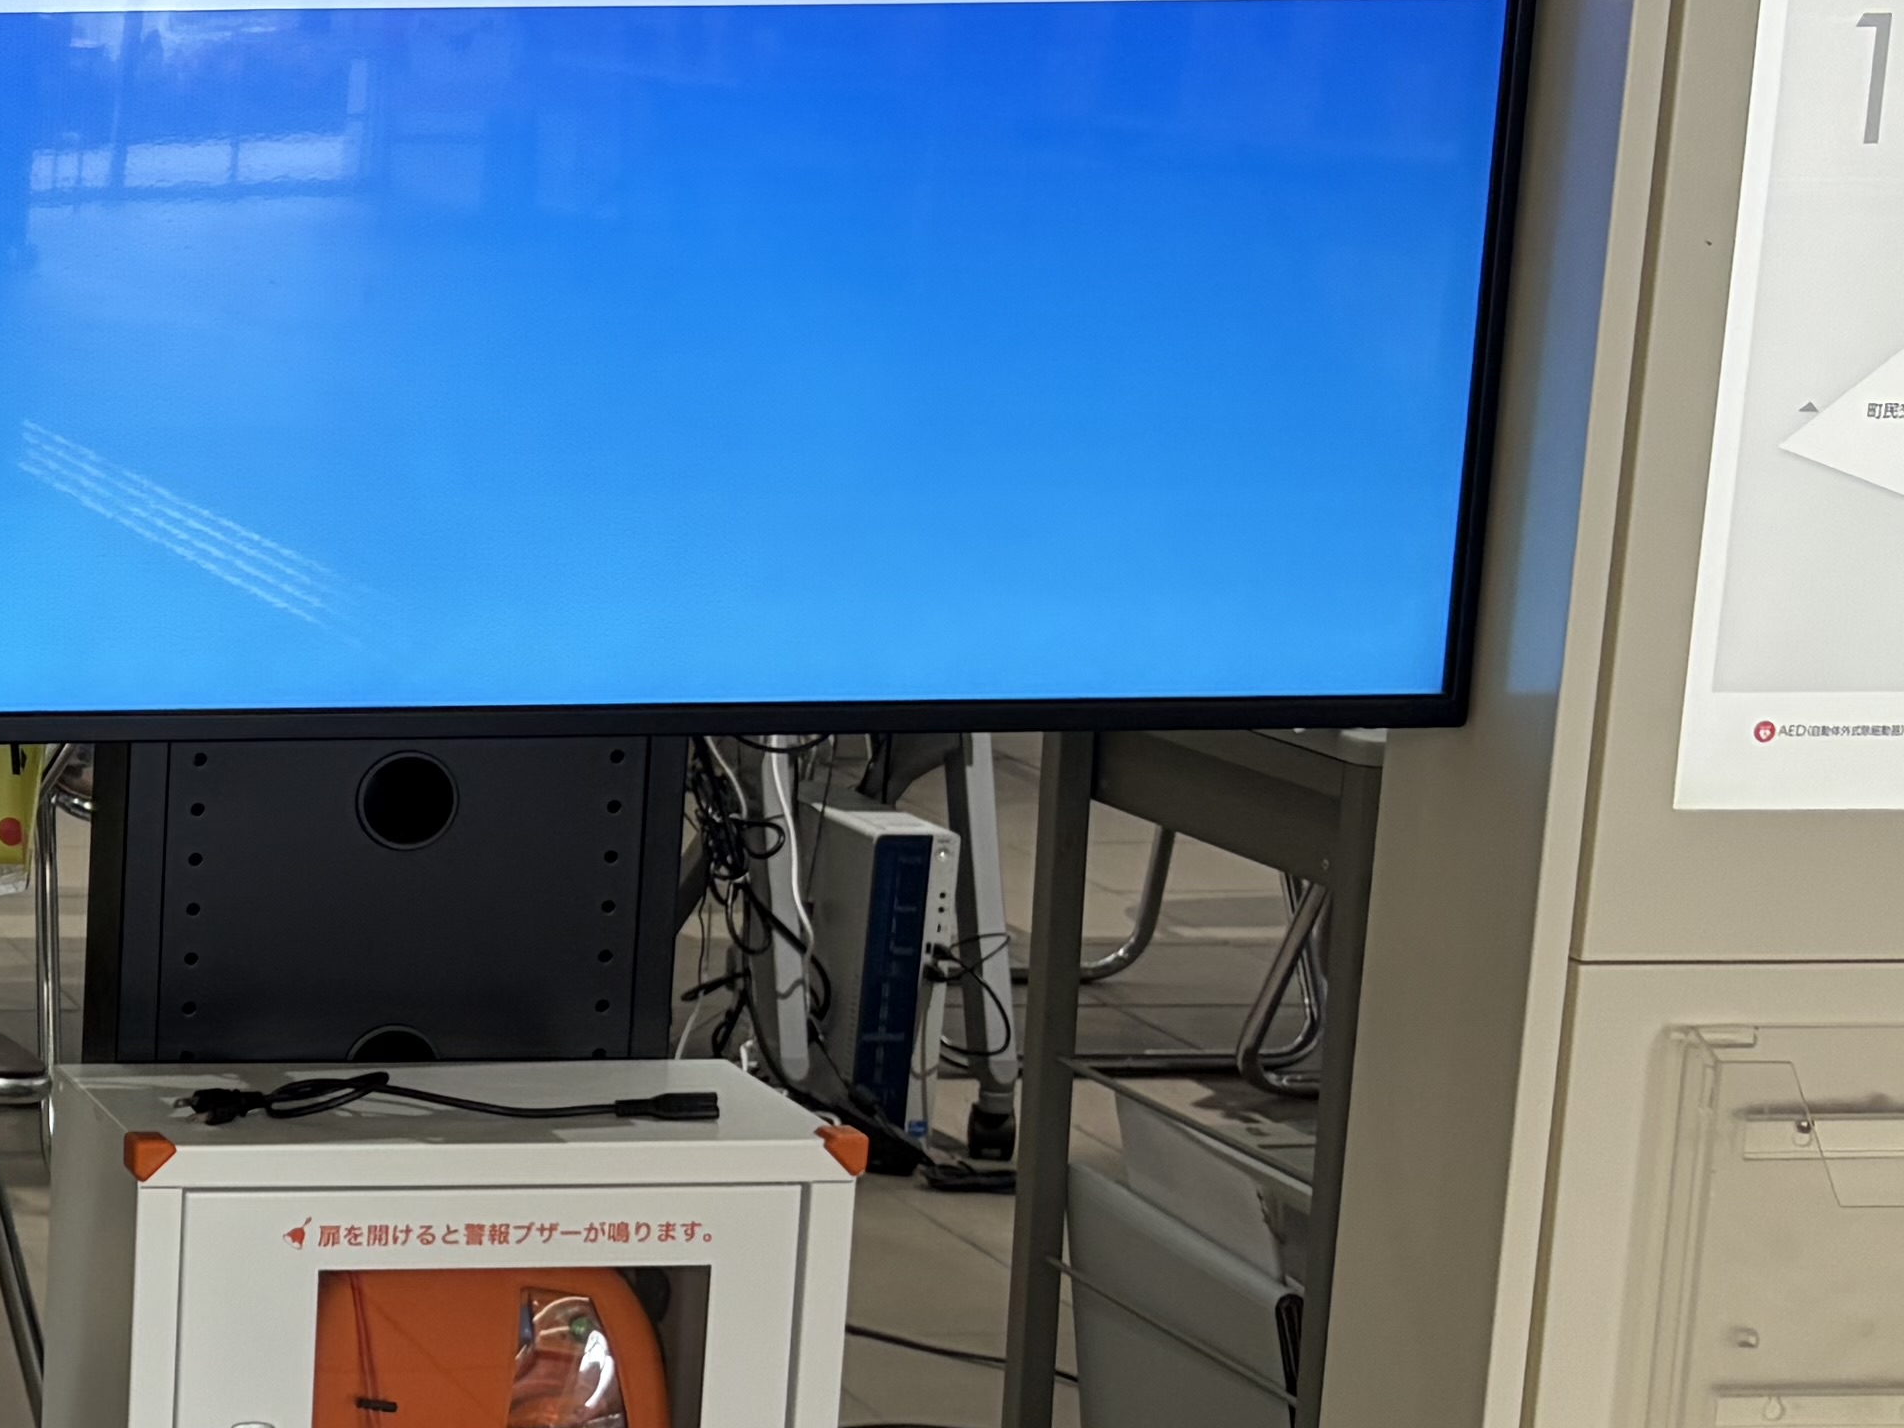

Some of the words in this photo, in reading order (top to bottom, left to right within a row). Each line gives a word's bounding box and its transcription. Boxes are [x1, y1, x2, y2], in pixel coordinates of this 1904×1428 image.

[318, 1219, 716, 1249] 扉を開けると警報ブザーが鳴ります。
